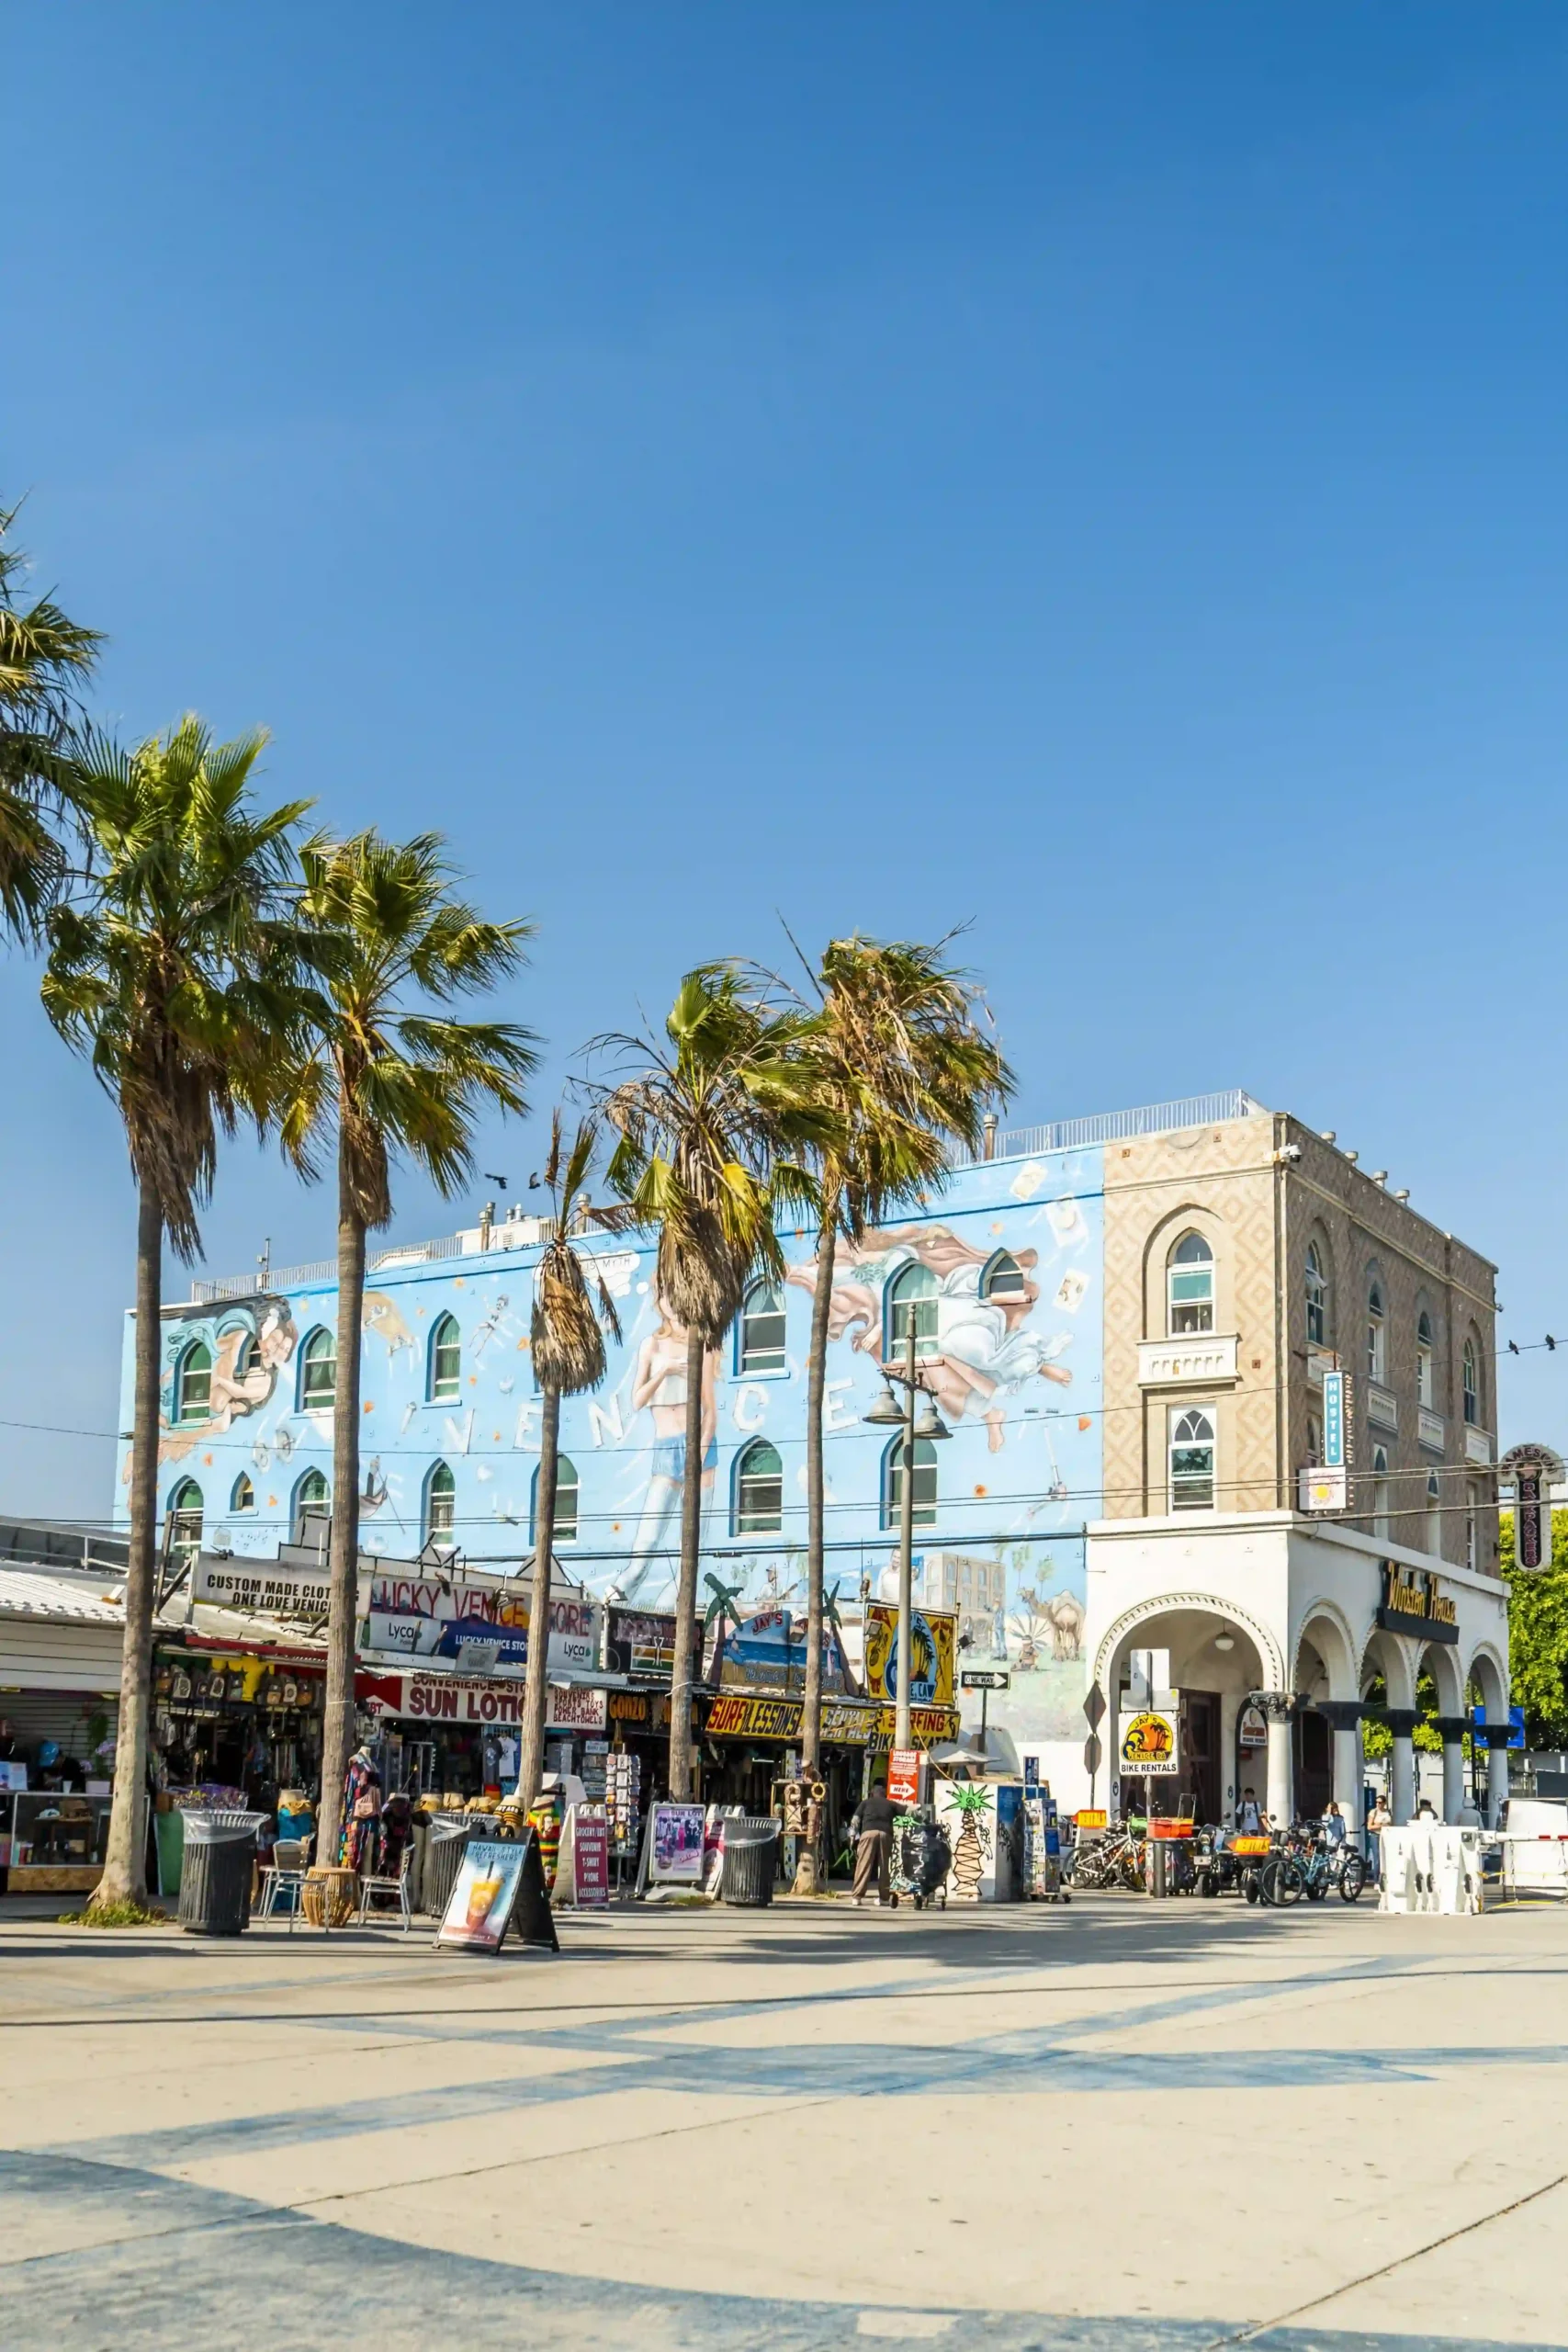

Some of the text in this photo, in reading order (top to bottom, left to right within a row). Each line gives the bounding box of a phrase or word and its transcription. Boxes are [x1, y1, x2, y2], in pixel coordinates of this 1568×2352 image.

[1327, 1381, 1338, 1457] HOSTEL
[207, 1574, 261, 1593] CUSTOM
[265, 1580, 299, 1597] MADE
[1386, 1560, 1456, 1624] Winston House
[231, 1591, 256, 1607] ONE
[260, 1595, 288, 1611] LOVE
[379, 1580, 442, 1620] LUCKY
[548, 1600, 590, 1637] TORE
[388, 1622, 414, 1640] Lyca
[751, 1611, 784, 1636] JAY'S
[563, 1642, 586, 1657] Lyca
[410, 1687, 457, 1718] SUN
[609, 1695, 647, 1721] GONZO
[706, 1700, 746, 1730] SURF
[745, 1701, 802, 1735] LESSONS
[1135, 1717, 1157, 1728] JAY'S
[1122, 1763, 1177, 1772] BIKE RENTALS
[580, 1841, 602, 1852] SOUVENIR
[474, 1851, 518, 1862] REFRESHERS
[582, 1857, 600, 1868] T-SHIRT
[583, 1872, 599, 1882] PHONE
[578, 1887, 606, 1898] ACCESSORIES
